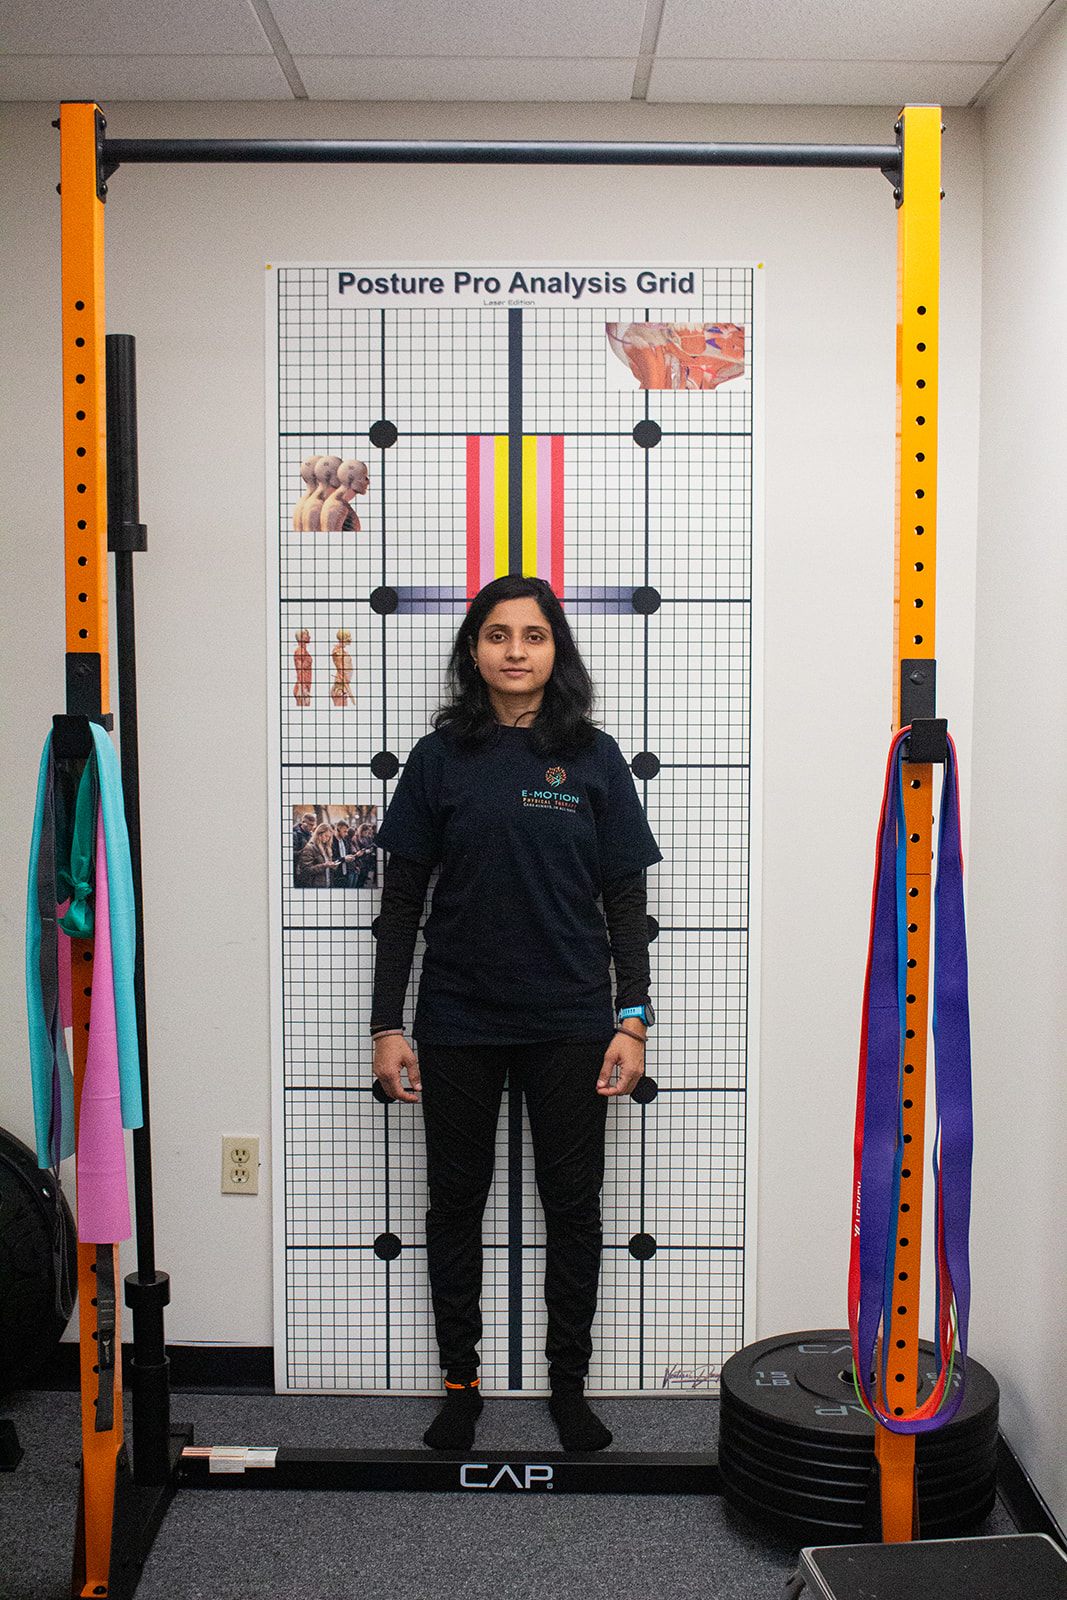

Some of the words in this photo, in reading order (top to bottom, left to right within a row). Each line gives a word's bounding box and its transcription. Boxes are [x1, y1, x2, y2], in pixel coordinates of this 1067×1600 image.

[338, 271, 445, 294] Posture
[454, 271, 501, 294] Pro
[508, 271, 627, 299] Analysis
[636, 271, 695, 294] Grid
[521, 790, 579, 804] E-MOTION
[460, 1464, 554, 1489] CAP
